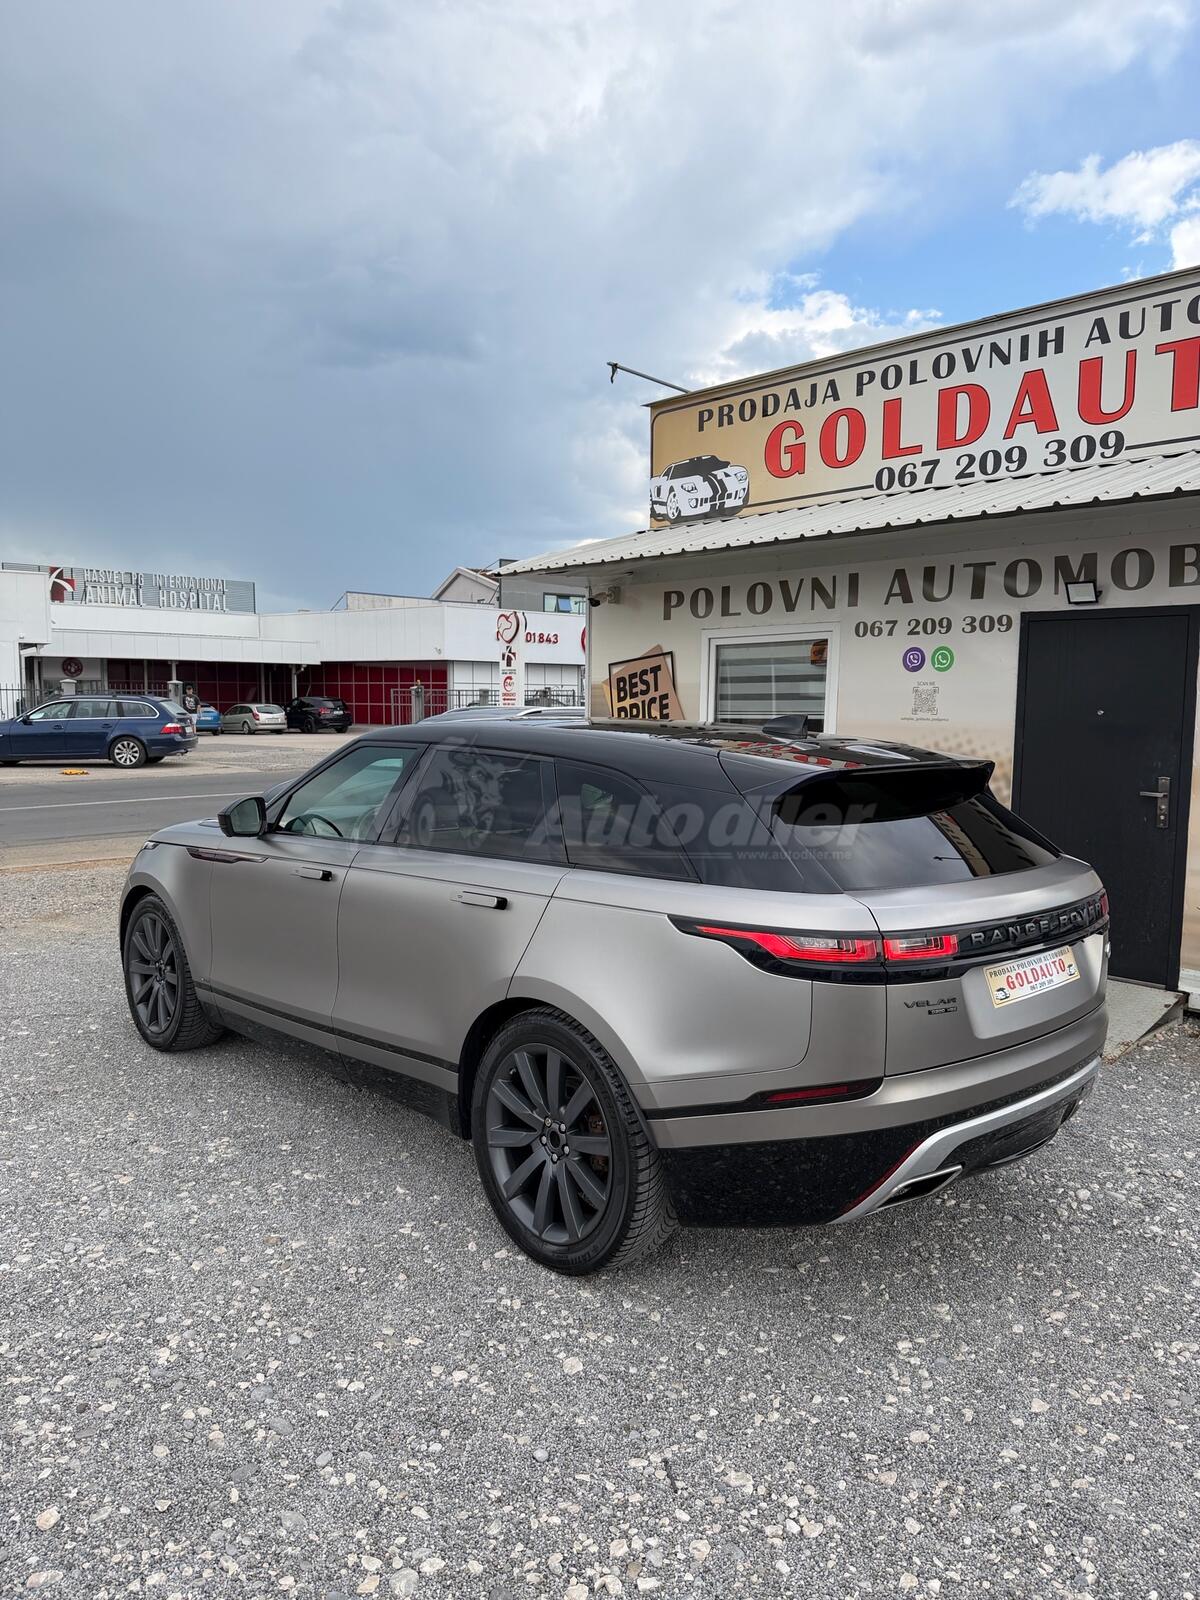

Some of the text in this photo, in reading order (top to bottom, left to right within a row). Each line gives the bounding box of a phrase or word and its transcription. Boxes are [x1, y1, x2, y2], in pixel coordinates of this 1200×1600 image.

[698, 378, 841, 433] PRODAJA
[856, 325, 1065, 398] POLOVNIH
[764, 336, 1200, 479] GOLDAUT
[874, 430, 1125, 492] 067 209 309
[84, 568, 228, 592] HASVET PG INTERNATIONAL
[663, 543, 1200, 621] POLOVNI AUTOMOB
[85, 585, 229, 611] ANIMAL HOSPITAL
[854, 613, 1013, 638] 067 209 309
[616, 664, 662, 703] BEST
[970, 919, 1050, 946] RANGE
[1006, 958, 1066, 990] GOLDAUTO
[904, 997, 957, 1009] VELAR
